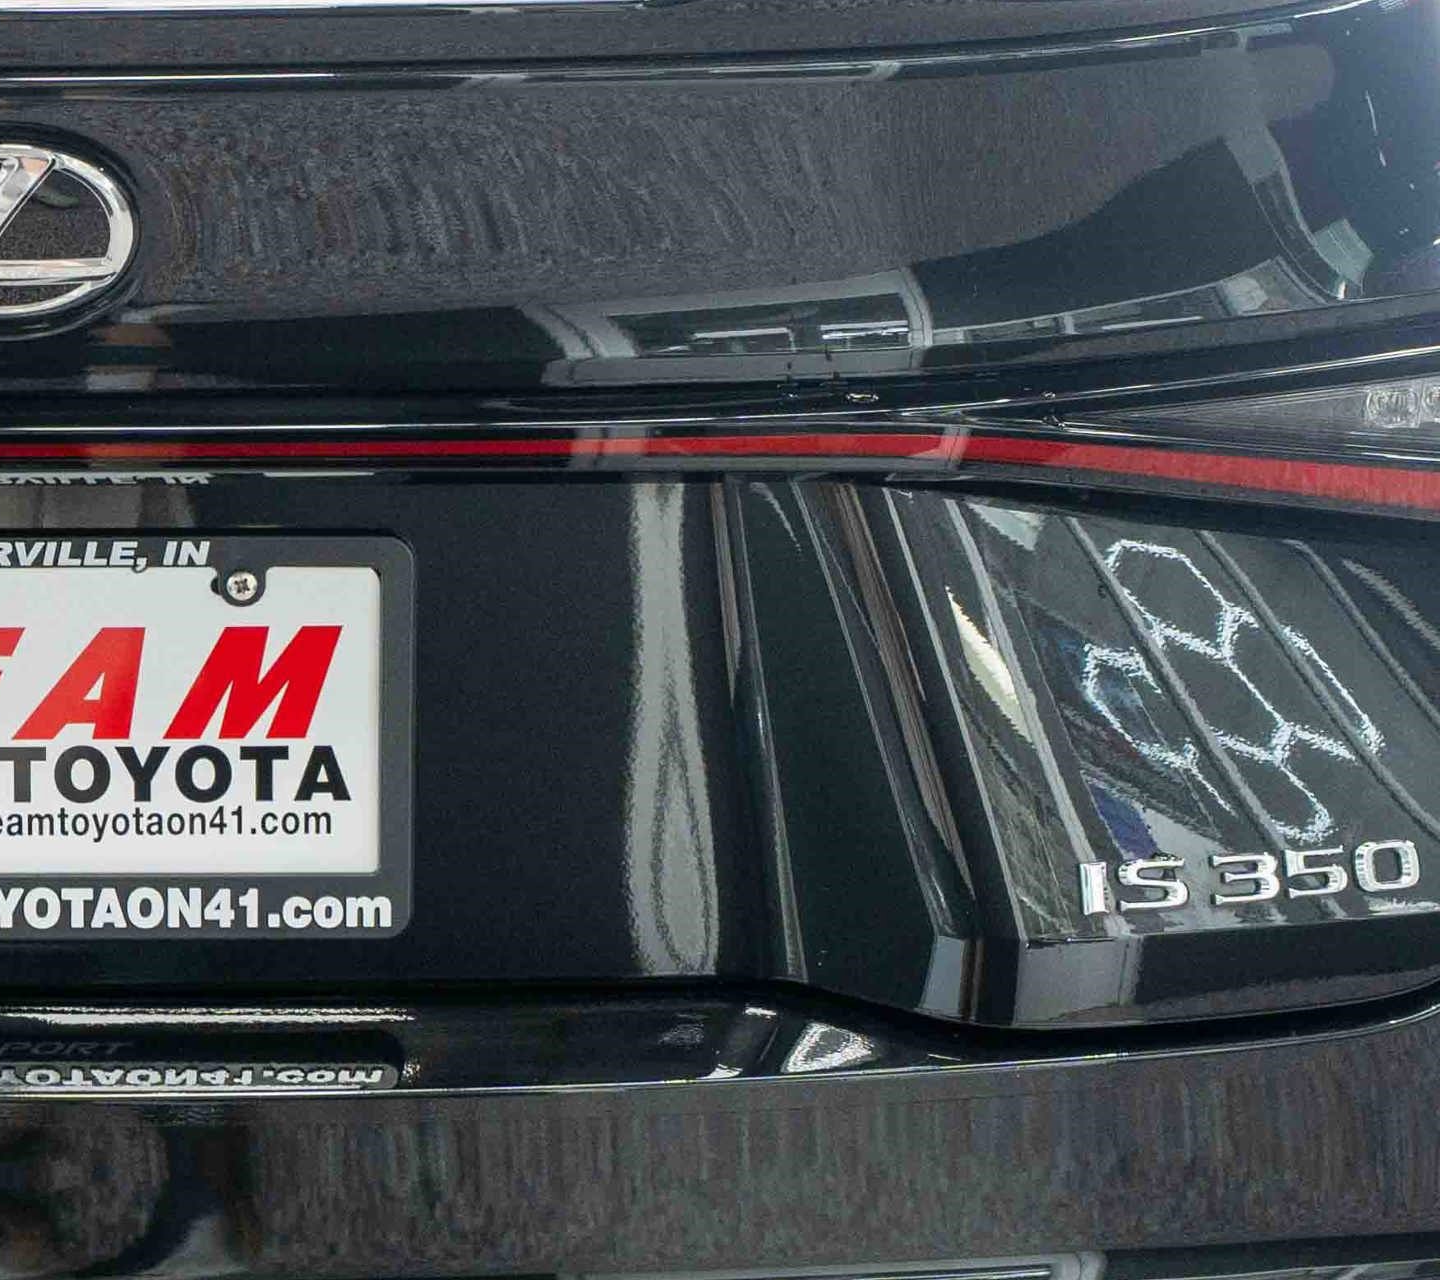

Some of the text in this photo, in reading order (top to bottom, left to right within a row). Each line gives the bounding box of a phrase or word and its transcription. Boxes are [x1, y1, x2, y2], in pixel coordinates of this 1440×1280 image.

[162, 540, 211, 568] IN
[1078, 838, 1421, 916] IS 350
